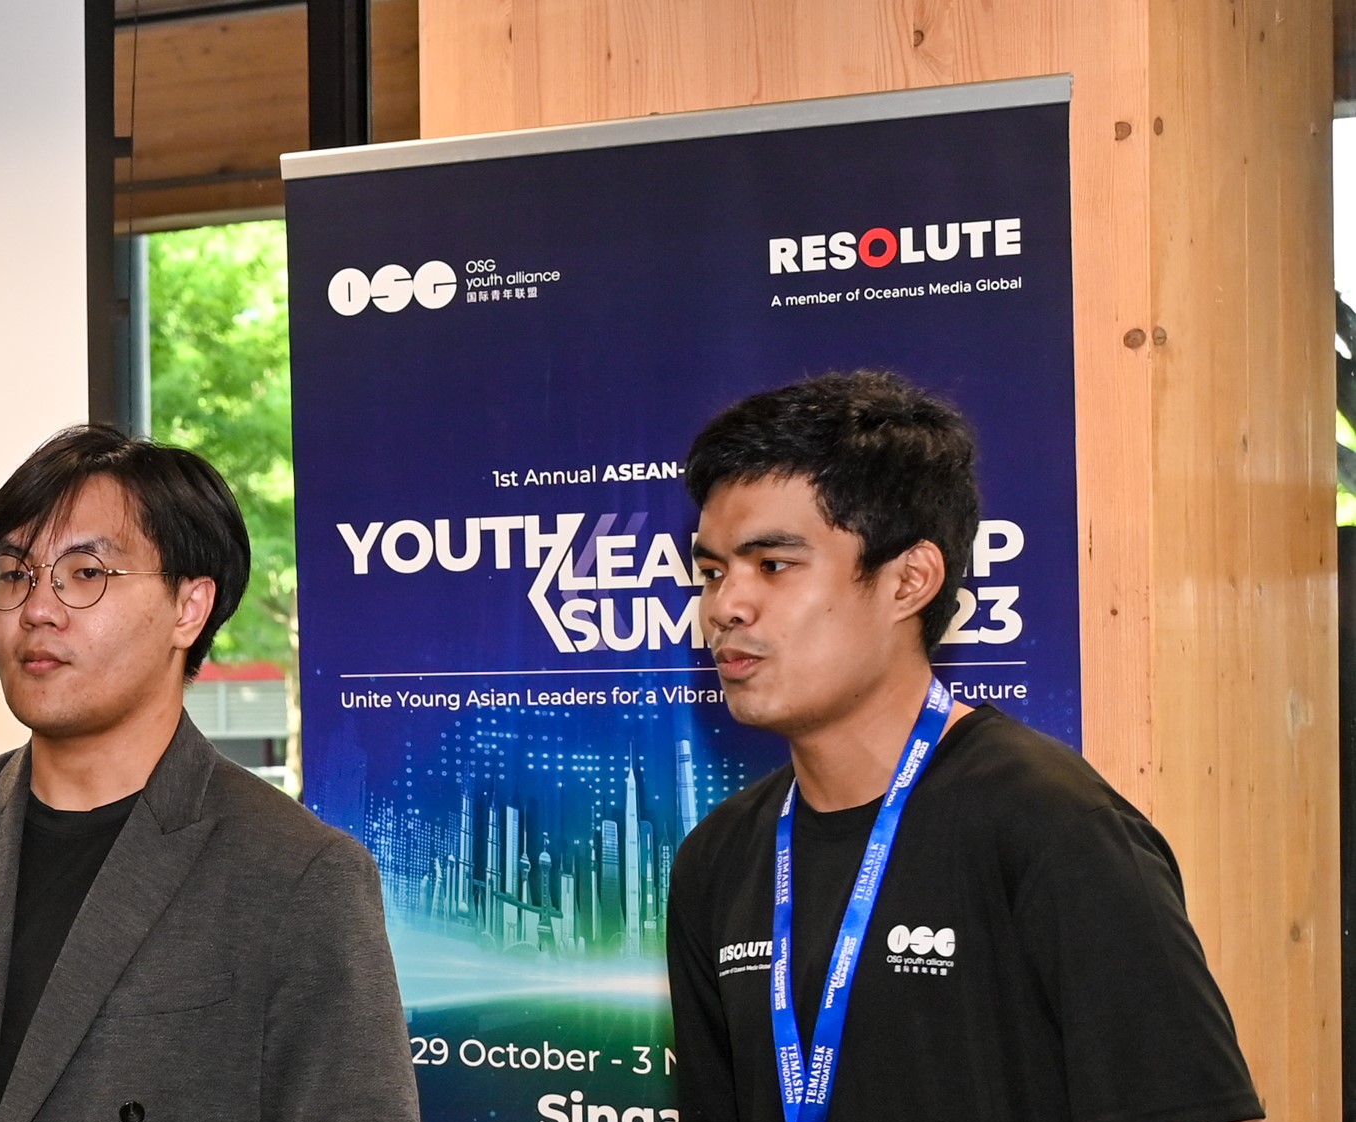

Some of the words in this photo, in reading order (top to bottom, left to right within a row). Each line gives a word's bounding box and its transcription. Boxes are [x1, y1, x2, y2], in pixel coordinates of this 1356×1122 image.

[768, 217, 1022, 275] RESOLUTE
[465, 259, 496, 274] OSG
[466, 274, 503, 290] youth
[506, 270, 561, 286] alliance
[328, 260, 457, 316] OSG
[466, 286, 538, 303] 国际青年联盟
[770, 295, 782, 307] A
[785, 291, 842, 306] member
[846, 289, 860, 302] of
[863, 286, 925, 300] Oceanus
[928, 281, 972, 295] Media
[976, 276, 1022, 292] Global
[492, 470, 518, 487] 1st
[523, 465, 596, 486] Annual
[336, 513, 586, 575] YOUTH
[341, 691, 392, 709] Unite
[397, 690, 461, 711] Young
[466, 689, 520, 707] Asian
[527, 687, 606, 707] Leaders
[611, 686, 641, 705] for
[645, 690, 656, 704] a
[950, 681, 1027, 699] Future
[854, 843, 879, 900] TEMASEK
[864, 844, 887, 901] FOUNDATION
[886, 955, 902, 964] OSG
[887, 924, 955, 957] OSG
[410, 1037, 449, 1066] 29
[458, 1039, 600, 1072] October
[632, 1045, 652, 1075] 3
[805, 1045, 826, 1104] TEMASEK
[780, 1047, 794, 1104] FOUNDATION
[816, 1047, 834, 1104] FOUNDATION
